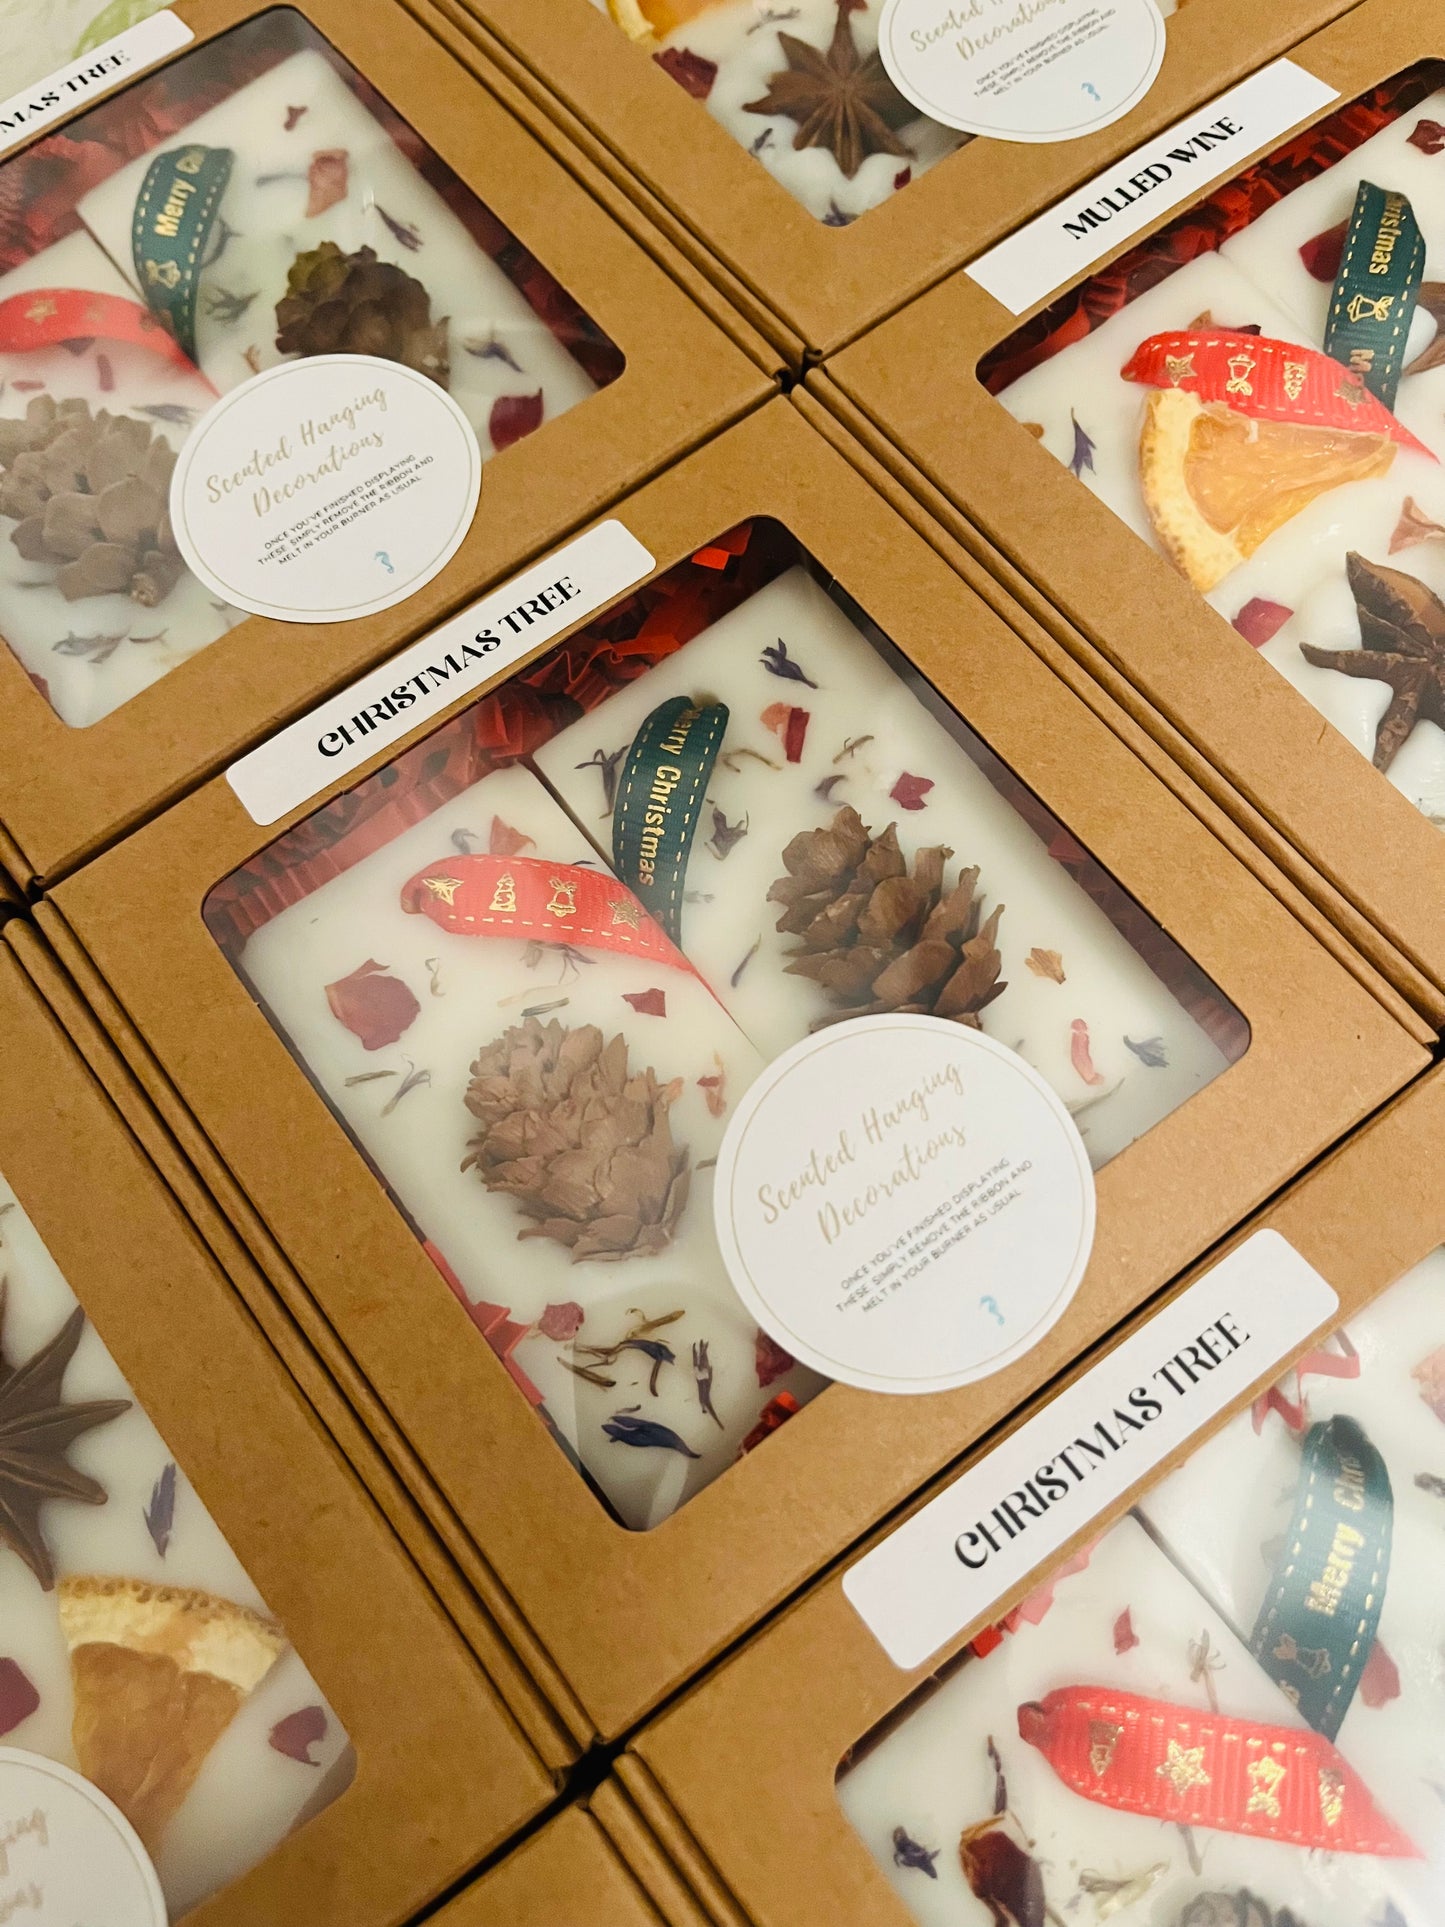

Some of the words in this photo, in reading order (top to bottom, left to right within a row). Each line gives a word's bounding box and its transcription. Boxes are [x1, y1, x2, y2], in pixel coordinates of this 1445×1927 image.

[60, 49, 131, 93] TREE
[956, 0, 1065, 61] Decoratio
[154, 177, 197, 237] Merry
[1062, 162, 1173, 240] MULLED
[1166, 116, 1244, 164] WINE
[206, 434, 293, 504] Scented
[299, 387, 388, 446] Hanging
[252, 430, 384, 517] Decorations
[264, 530, 289, 551] ONCE
[323, 487, 363, 513] FINISHED
[364, 454, 417, 489] DISPLAYING
[289, 523, 321, 547] SIMPLY
[322, 500, 359, 526] REMOVE
[360, 487, 378, 502] THE
[378, 467, 414, 490] RIBBON
[414, 455, 434, 470] AND
[278, 547, 302, 566] MELT
[303, 540, 314, 551] IN
[315, 523, 339, 543] YOUR
[340, 501, 376, 527] BURNER
[378, 493, 392, 505] AS
[391, 475, 422, 496] USUAL
[318, 629, 501, 757] CHRISTMAS
[498, 576, 581, 634] TREE
[638, 765, 682, 887] Christmas
[757, 1130, 856, 1225] Scented
[861, 1061, 965, 1145] Hanging
[816, 1124, 968, 1246] Decorations
[840, 1264, 869, 1290] ONCE
[906, 1201, 951, 1239] FINISHED
[952, 1157, 1010, 1204] DISPLAYING
[862, 1287, 888, 1312] MELT
[890, 1278, 902, 1292] IN
[902, 1255, 931, 1281] YOUR
[931, 1224, 972, 1260] BURNER
[973, 1212, 988, 1228] AS
[990, 1189, 1022, 1216] USUAL
[871, 1255, 908, 1286] SIMPLY
[909, 1222, 950, 1257] REMOVE
[950, 1206, 971, 1224] THE
[972, 1178, 1009, 1209] RIBBON
[1011, 1159, 1033, 1180] AND
[954, 1386, 1162, 1569] CHRISTMAS
[1152, 1312, 1251, 1396] TREE
[1304, 1522, 1365, 1616] Merry
